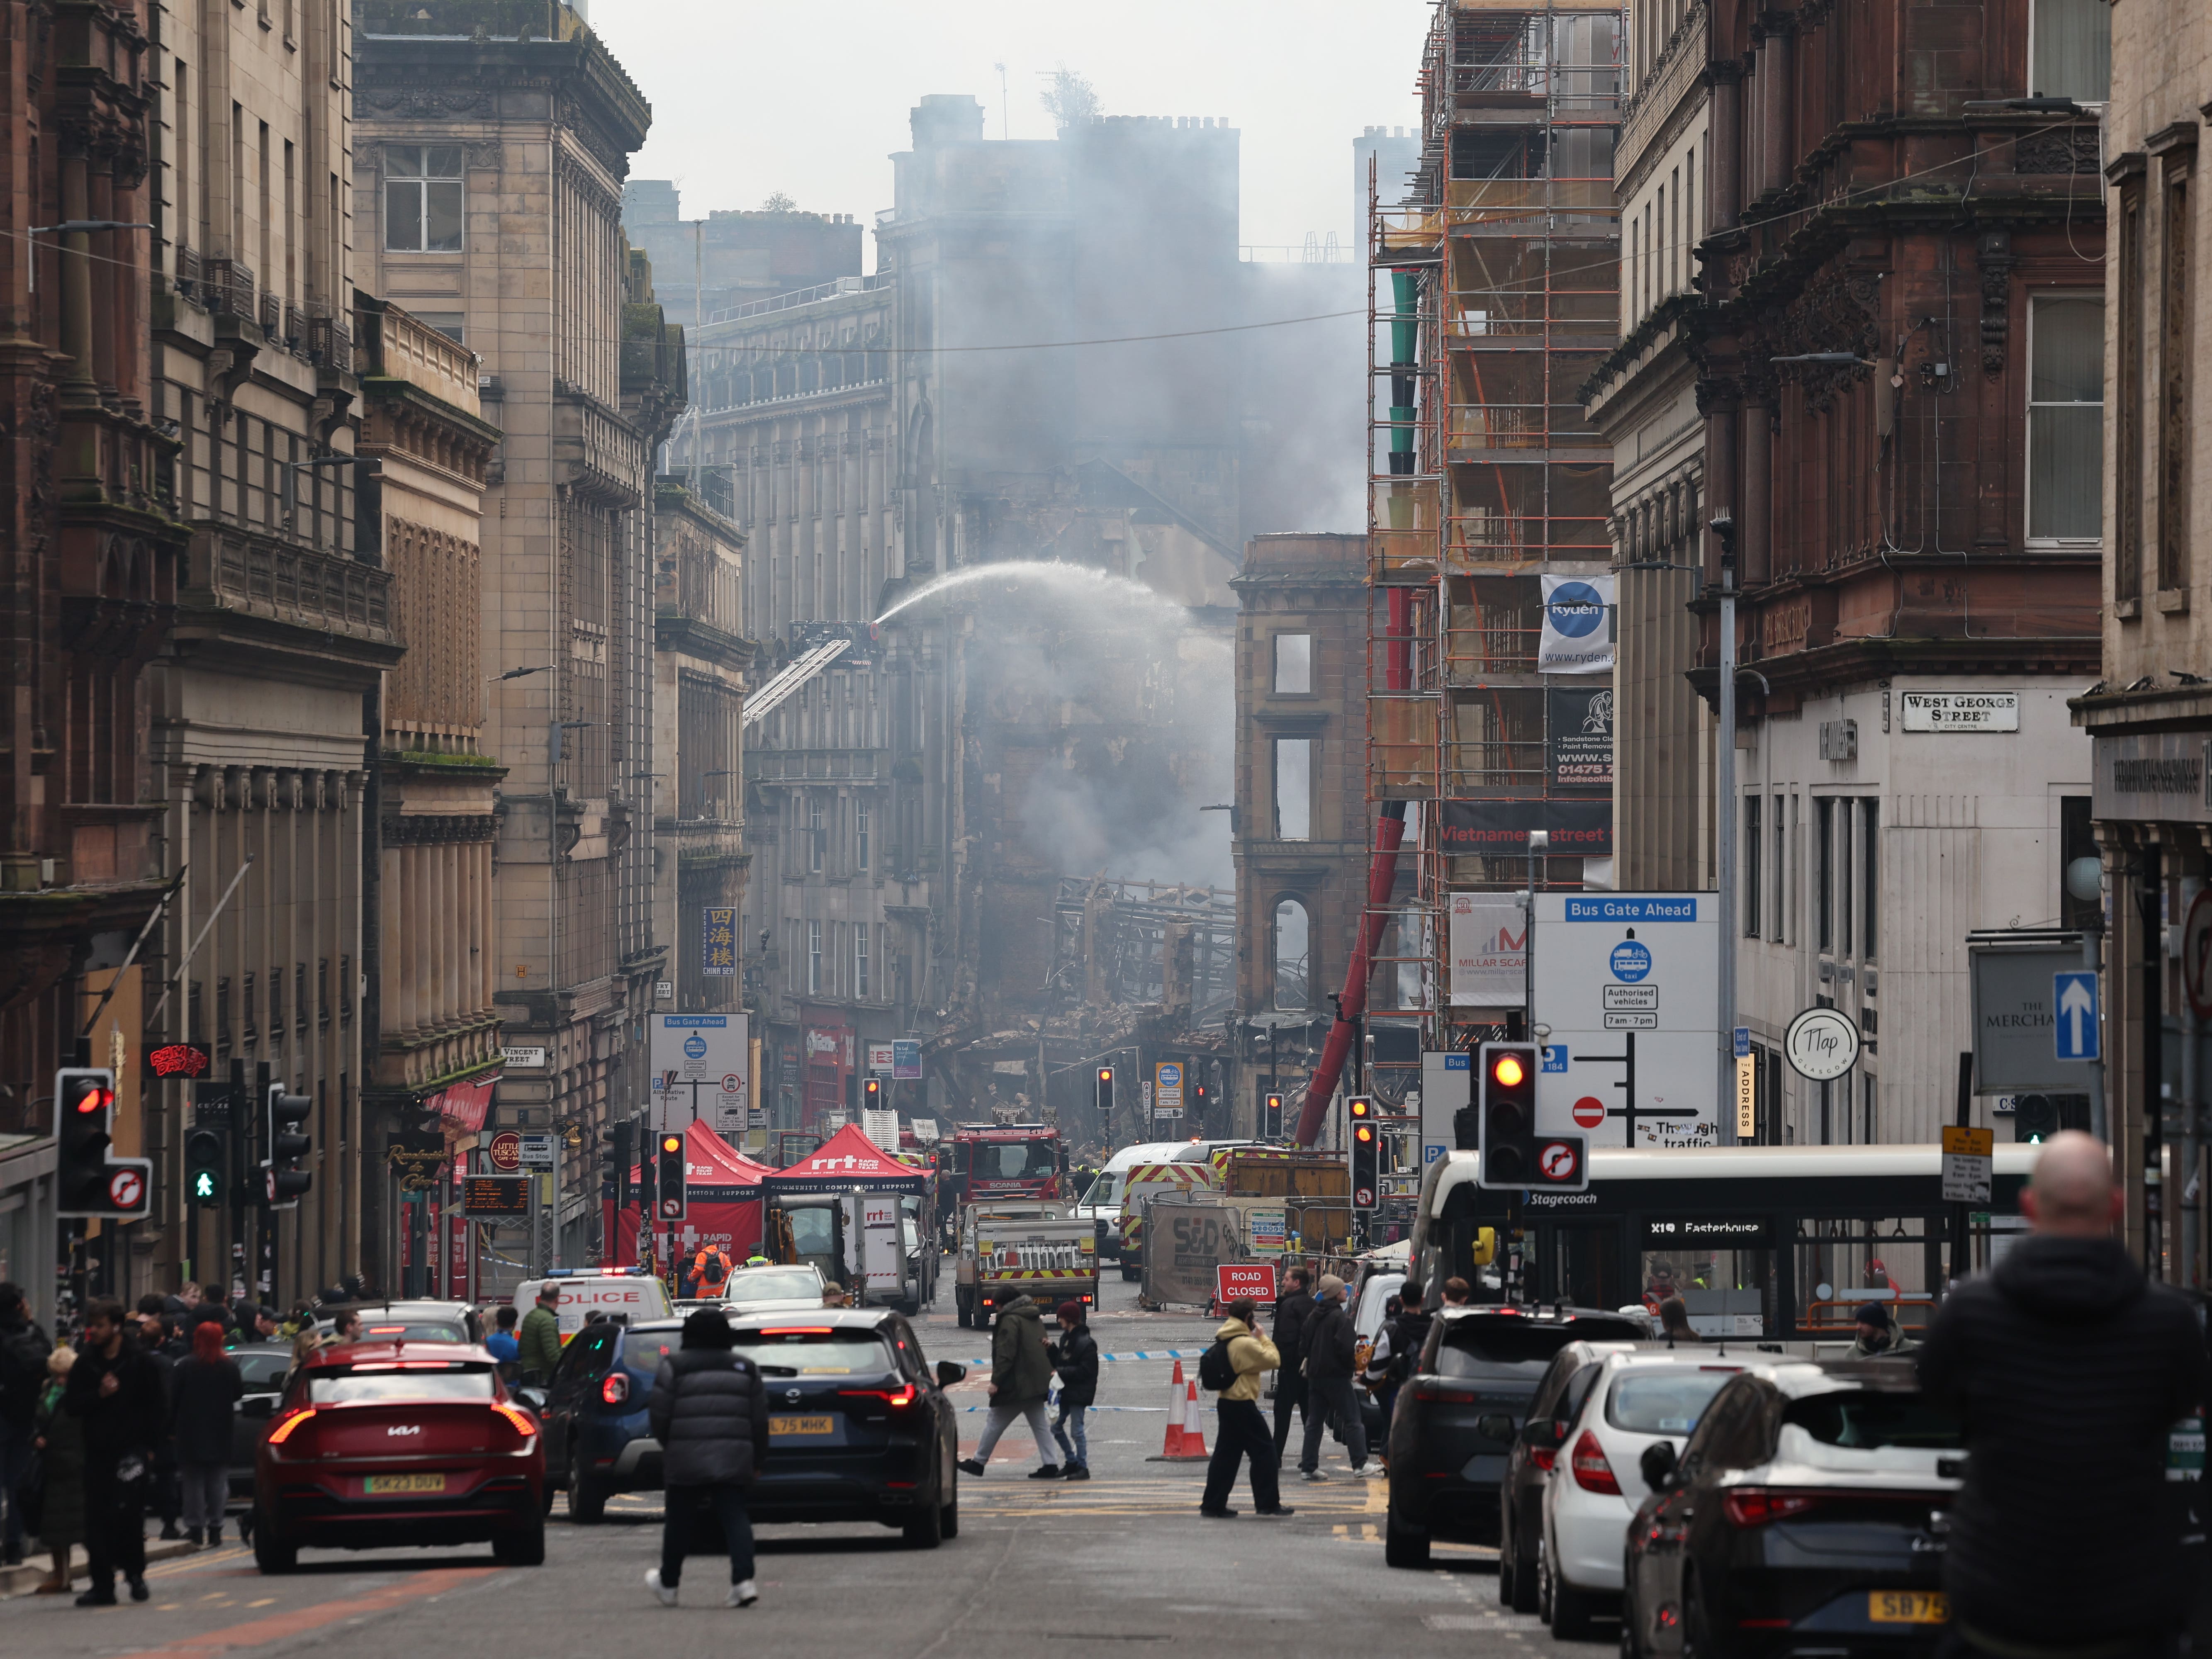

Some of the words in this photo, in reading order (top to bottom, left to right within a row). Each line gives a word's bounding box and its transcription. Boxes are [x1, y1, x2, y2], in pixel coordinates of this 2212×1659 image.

[1908, 696, 1950, 708] WEST
[1954, 696, 2015, 708] GEORGE
[1932, 710, 1991, 721] STREET
[1557, 754, 1613, 762] www.s
[1558, 765, 1603, 774] 01475
[1441, 826, 1529, 842] Vietnames
[1550, 828, 1604, 842] street
[1571, 904, 1598, 916] Bus
[1604, 904, 1640, 916] Gate
[1645, 904, 1691, 916] Ahead
[709, 909, 734, 966] 四海楼
[2022, 1002, 2043, 1011] THE
[1798, 1058, 1847, 1074] GLASGOW
[654, 1079, 661, 1087] P
[1664, 1138, 1711, 1148] traffic
[812, 1155, 857, 1170] rrt
[1531, 1193, 1597, 1208] Stagecoach
[866, 1210, 884, 1221] rrt
[703, 1233, 732, 1242] RAPID
[1231, 1272, 1261, 1281] ROAD
[1227, 1287, 1268, 1296] CLOSED
[1650, 1304, 1656, 1314] 6
[387, 1425, 420, 1436] KIA
[770, 1419, 797, 1431] L75
